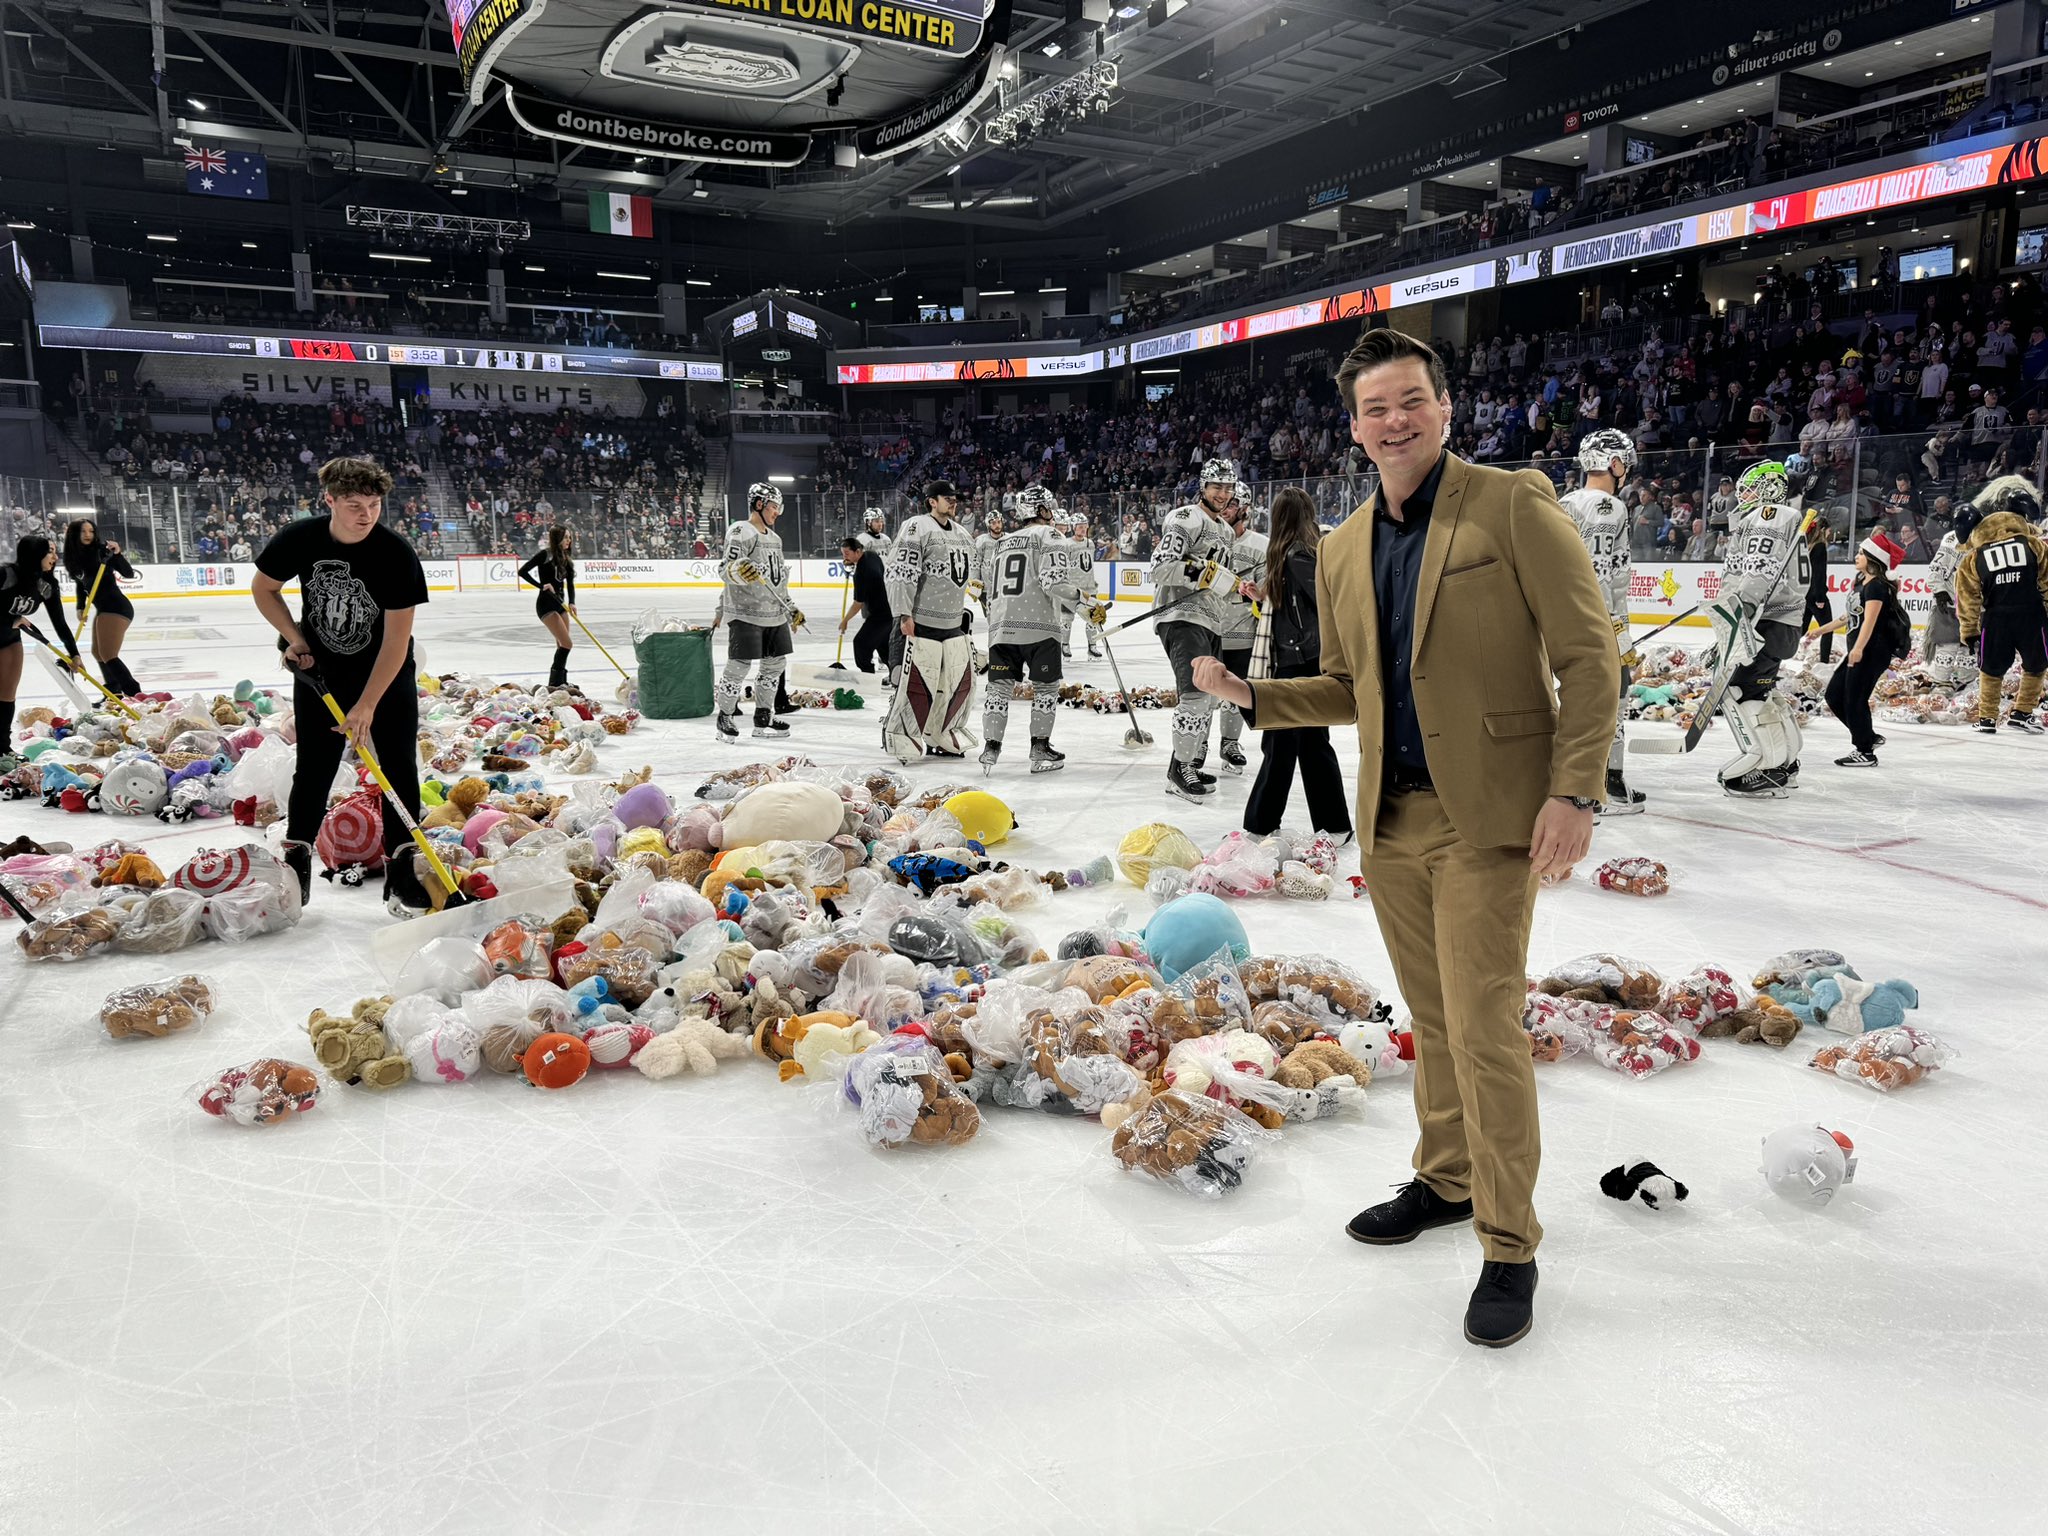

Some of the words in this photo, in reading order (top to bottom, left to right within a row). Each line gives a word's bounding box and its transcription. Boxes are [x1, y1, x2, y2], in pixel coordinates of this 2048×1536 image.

[861, 2, 955, 46] CENTER
[1734, 55, 1769, 76] silver
[1772, 40, 1817, 64] society
[876, 73, 976, 145] dontbebroke.com
[1582, 104, 1619, 122] TOYOTA
[557, 110, 772, 154] dontbebroke.com
[1316, 184, 1348, 204] BELL
[1813, 178, 1879, 219] COACHELLA
[1879, 170, 1924, 206] VALLEY
[1708, 210, 1734, 240] HSK
[1563, 236, 1613, 270] HENDERSON
[1612, 229, 1642, 260] SILVER
[1405, 277, 1459, 296] VERSUS
[228, 342, 251, 350] SHOTS
[263, 341, 272, 352] 8
[365, 345, 378, 361] 0
[390, 350, 404, 358] 1ST
[410, 350, 438, 360] 3:52
[456, 349, 466, 365] 1
[1041, 361, 1086, 370] VERSUS
[242, 372, 370, 396] SILVER
[450, 382, 592, 405] KNIGHTS
[728, 547, 739, 560] 5
[1161, 534, 1184, 555] 83
[1593, 535, 1614, 555] 13
[1748, 537, 1773, 554] 68
[897, 549, 919, 566] 32
[1049, 552, 1067, 567] 19
[1983, 542, 2027, 572] 00
[423, 569, 454, 578] ESORT
[992, 553, 1027, 600] 19
[1630, 577, 1658, 587] ICKEN
[1697, 577, 1721, 589] CHIC
[1995, 572, 2021, 585] BLUFF
[1904, 599, 1932, 611] NEVA
[903, 641, 914, 675] CCM
[1731, 705, 1752, 747] TRUE
